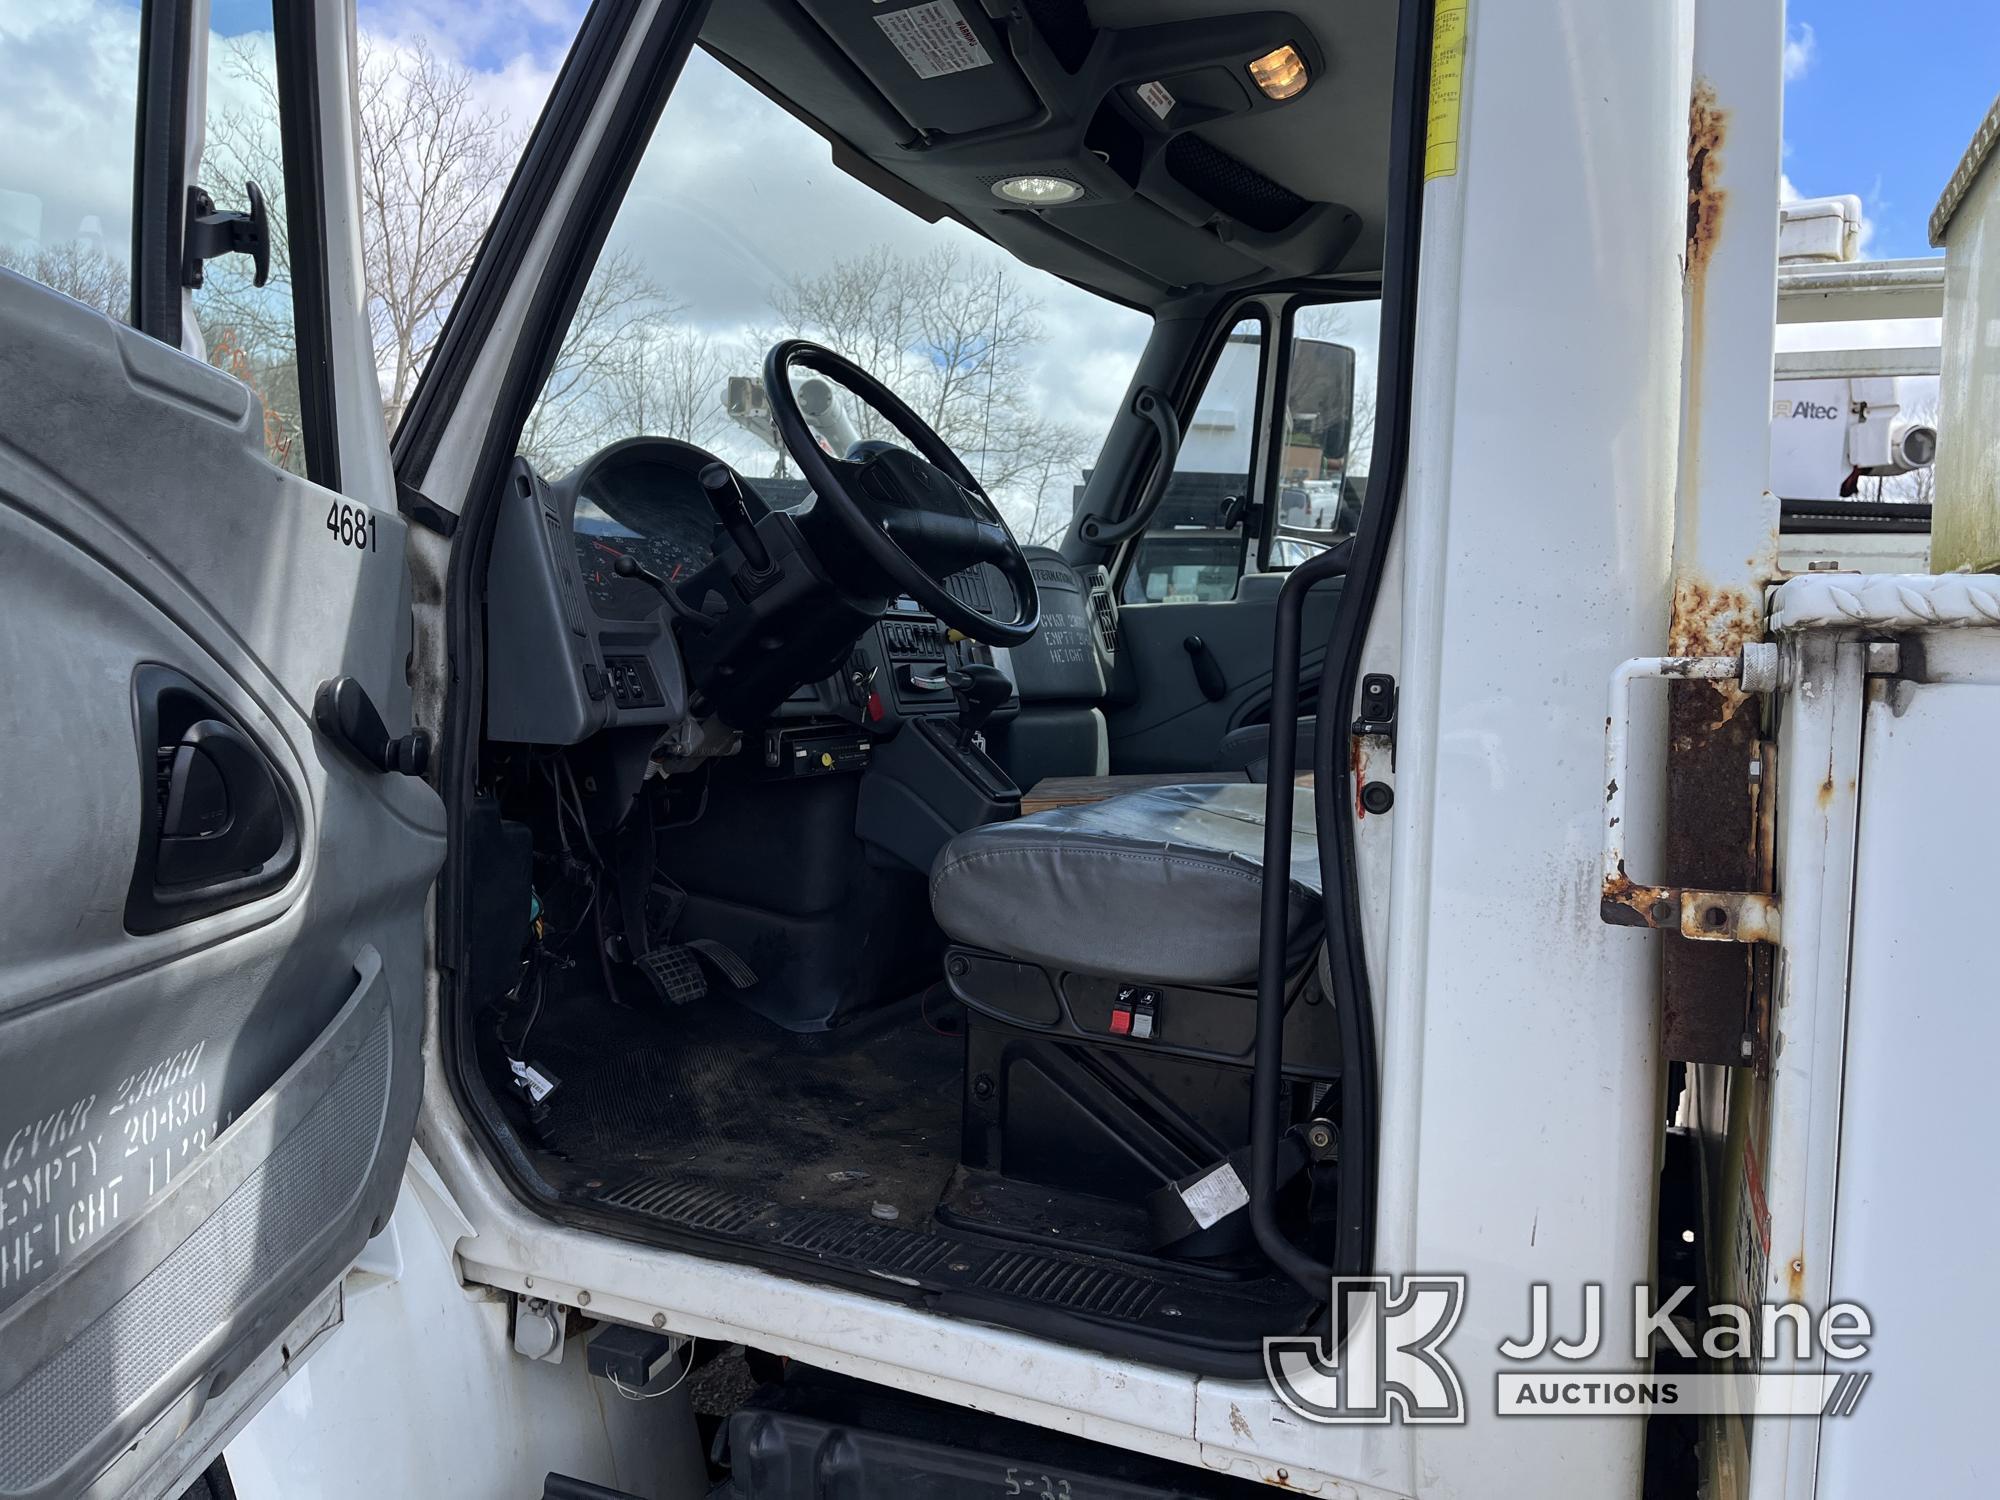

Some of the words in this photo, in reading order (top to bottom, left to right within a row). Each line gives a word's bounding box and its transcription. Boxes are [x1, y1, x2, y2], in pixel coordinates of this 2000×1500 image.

[1792, 401, 1839, 420] Altec
[327, 499, 376, 552] 4681
[1044, 631, 1075, 646] EMPTY
[1050, 648, 1084, 664] HEIGHT
[109, 1040, 205, 1116] 23660
[0, 1135, 102, 1231] EMPTY
[124, 1081, 206, 1158] 20430
[1, 1175, 123, 1288] HEIGHT
